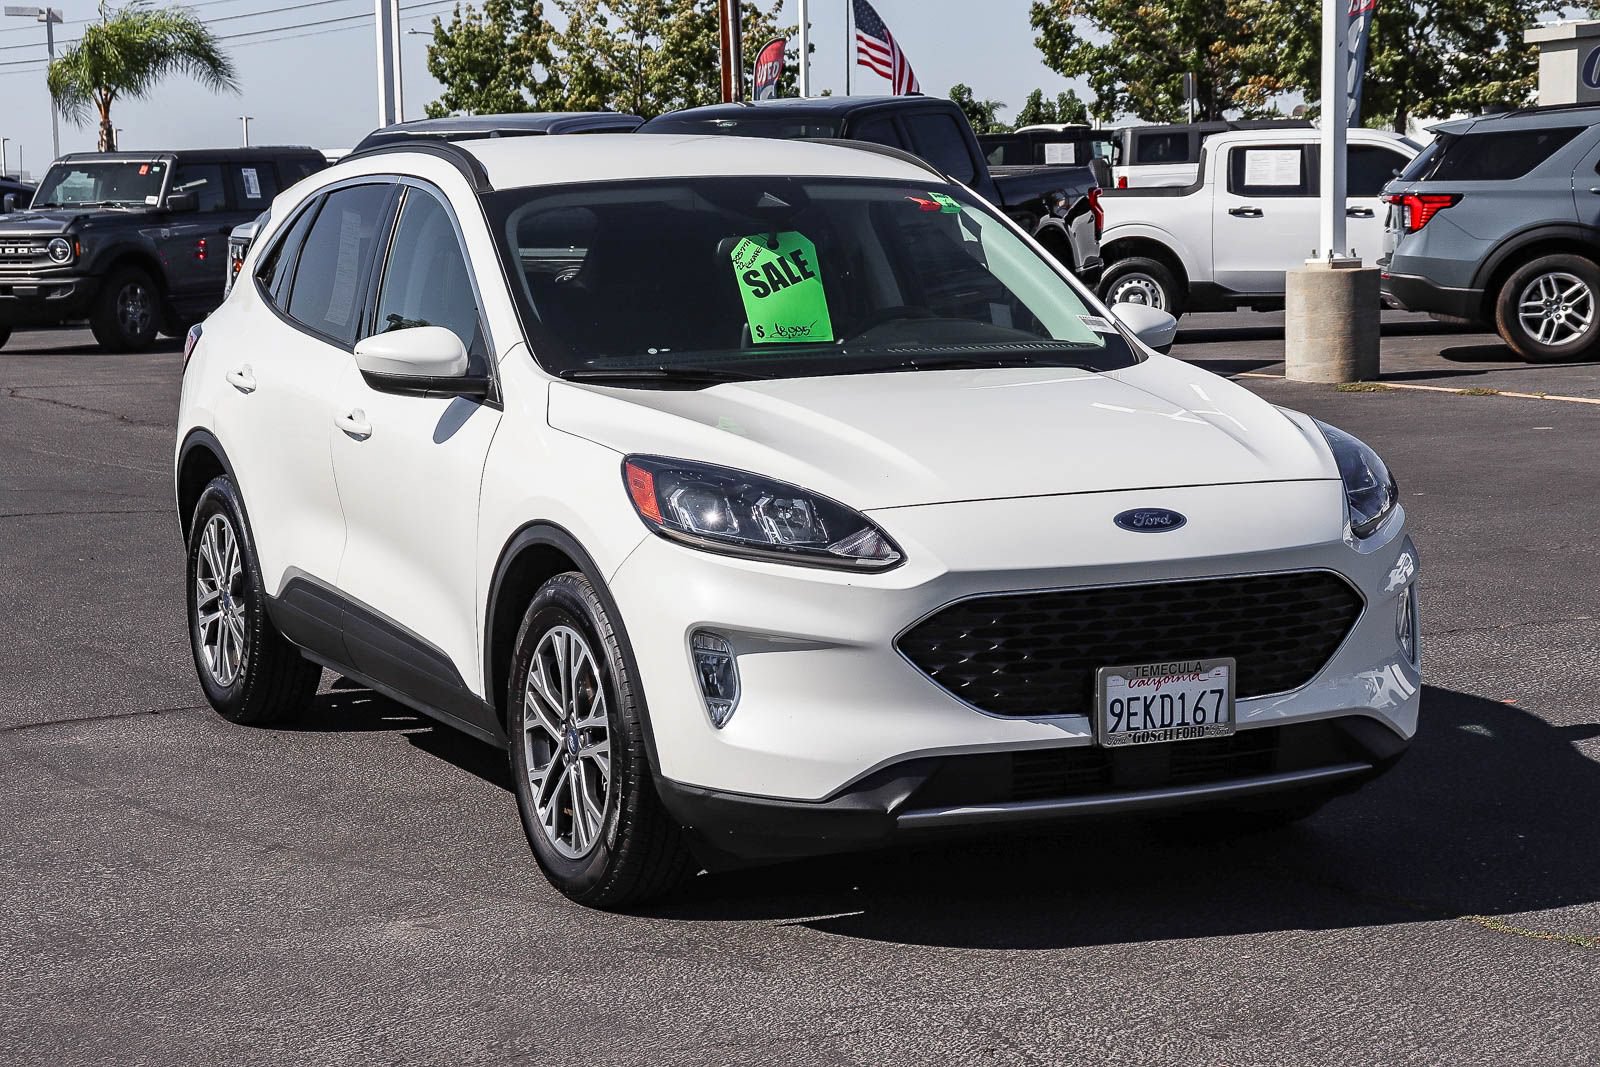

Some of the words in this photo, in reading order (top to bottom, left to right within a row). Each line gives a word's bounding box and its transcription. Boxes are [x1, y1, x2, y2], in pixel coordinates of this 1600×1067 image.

[757, 61, 780, 86] USED
[743, 249, 816, 298] SALE
[755, 324, 765, 339] $
[1133, 511, 1172, 527] Ford
[1134, 661, 1203, 677] TEMECULA
[1128, 672, 1209, 691] California
[1108, 688, 1225, 733] 9EKD167
[1176, 725, 1205, 739] FORD
